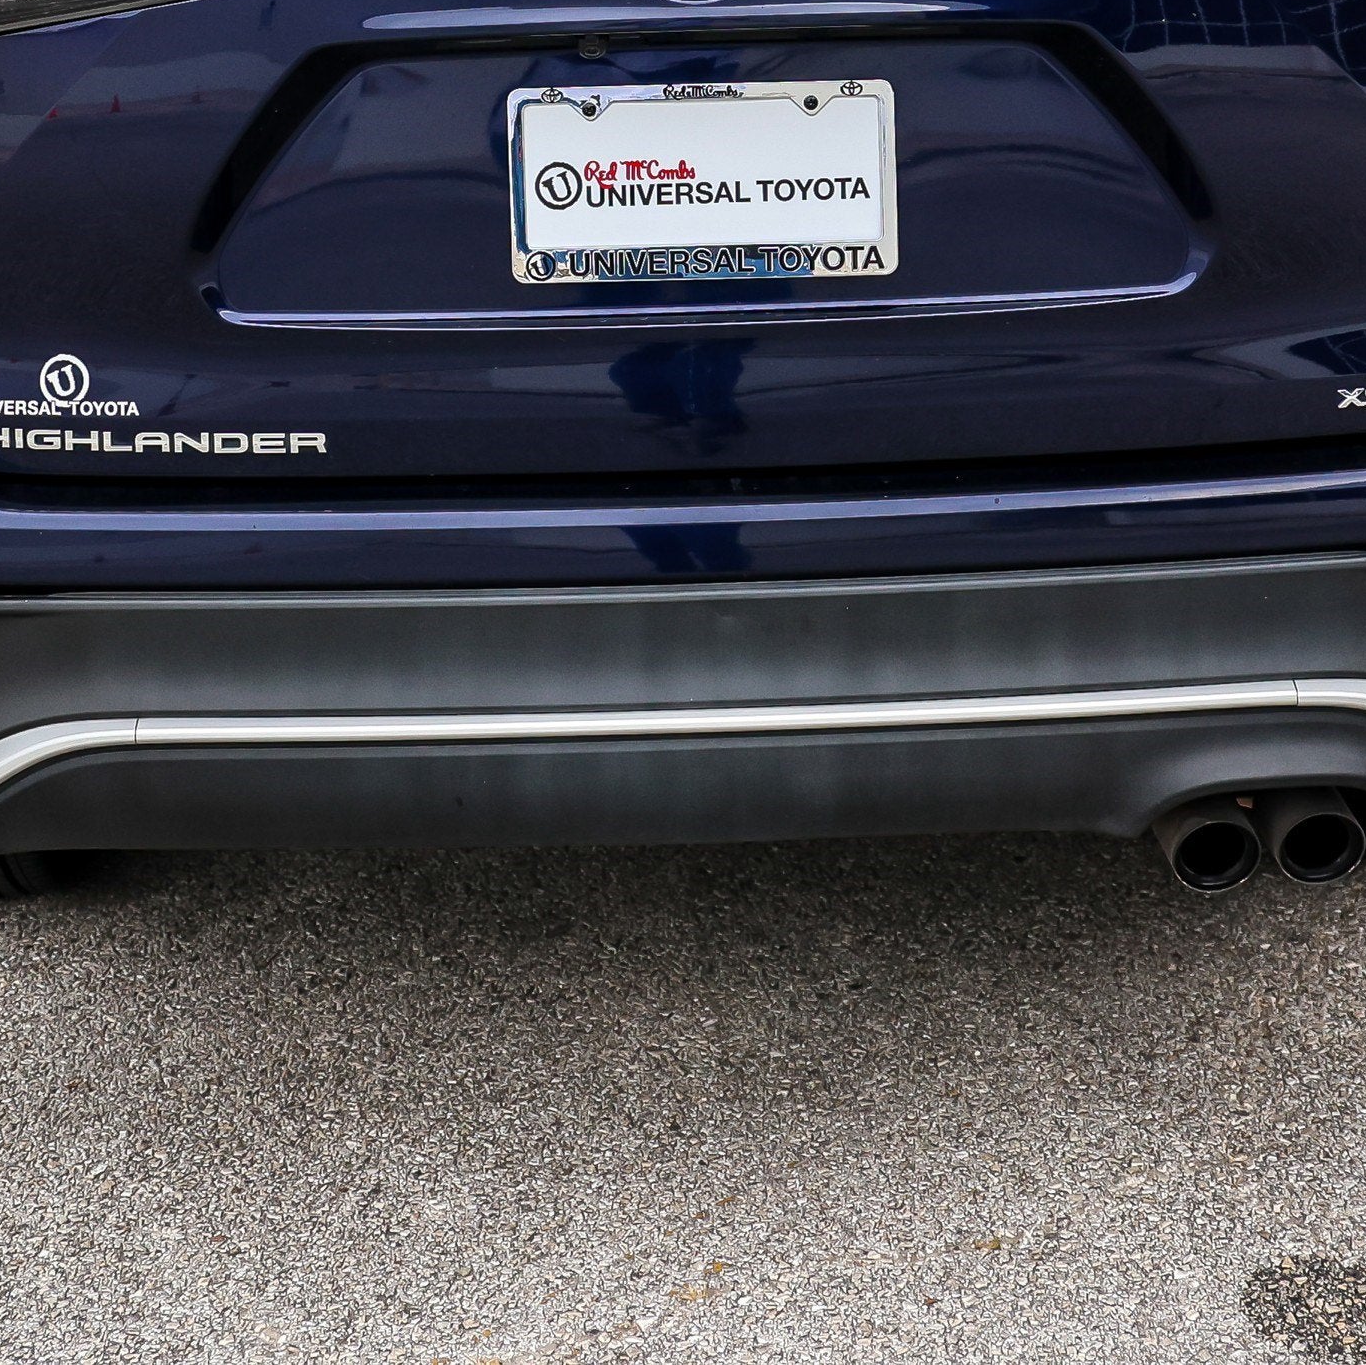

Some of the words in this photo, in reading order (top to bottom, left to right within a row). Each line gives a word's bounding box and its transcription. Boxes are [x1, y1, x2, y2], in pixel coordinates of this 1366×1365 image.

[584, 160, 617, 189] Red
[620, 160, 696, 181] McCombs
[586, 180, 751, 208] UNIVERSAL
[756, 177, 871, 204] TOYOTA
[569, 247, 756, 277] UNIVERSAL
[758, 245, 885, 273] TOYOTA
[69, 400, 140, 417] TOYOTA
